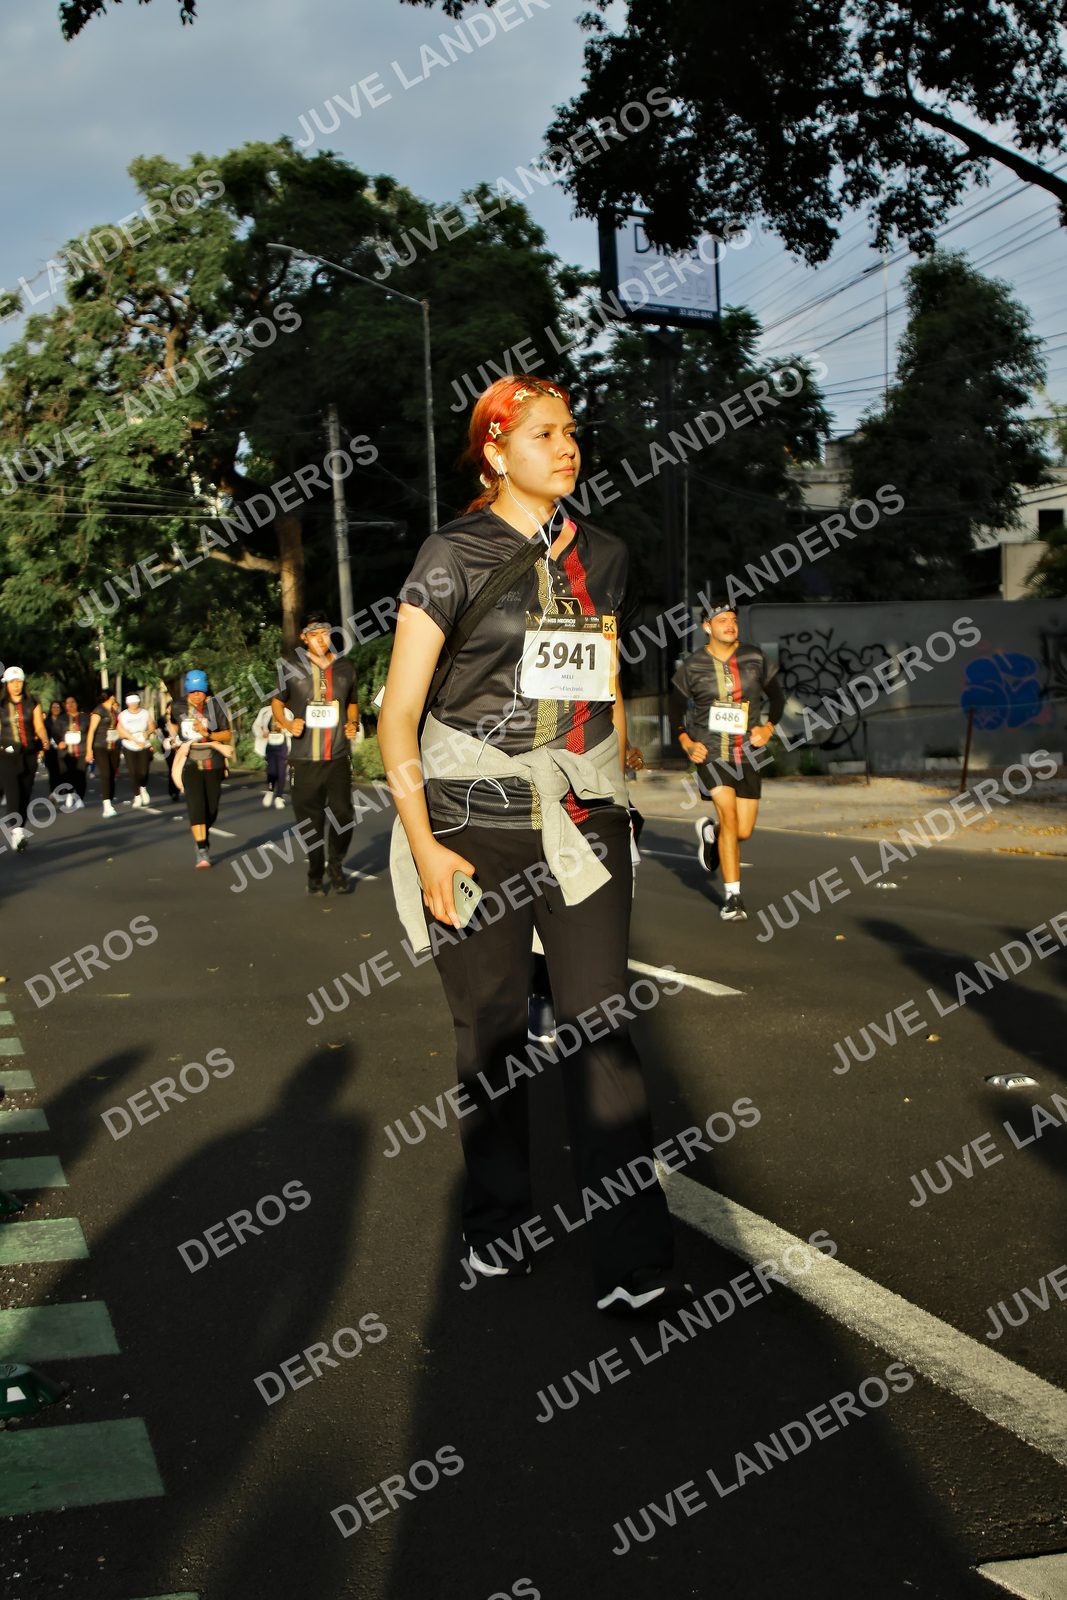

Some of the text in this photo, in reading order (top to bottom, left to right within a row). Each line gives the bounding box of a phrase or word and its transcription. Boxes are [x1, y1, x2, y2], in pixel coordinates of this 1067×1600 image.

[780, 628, 834, 649] TOY
[535, 641, 597, 671] 5941
[311, 709, 331, 718] 6201
[715, 711, 741, 723] 6486
